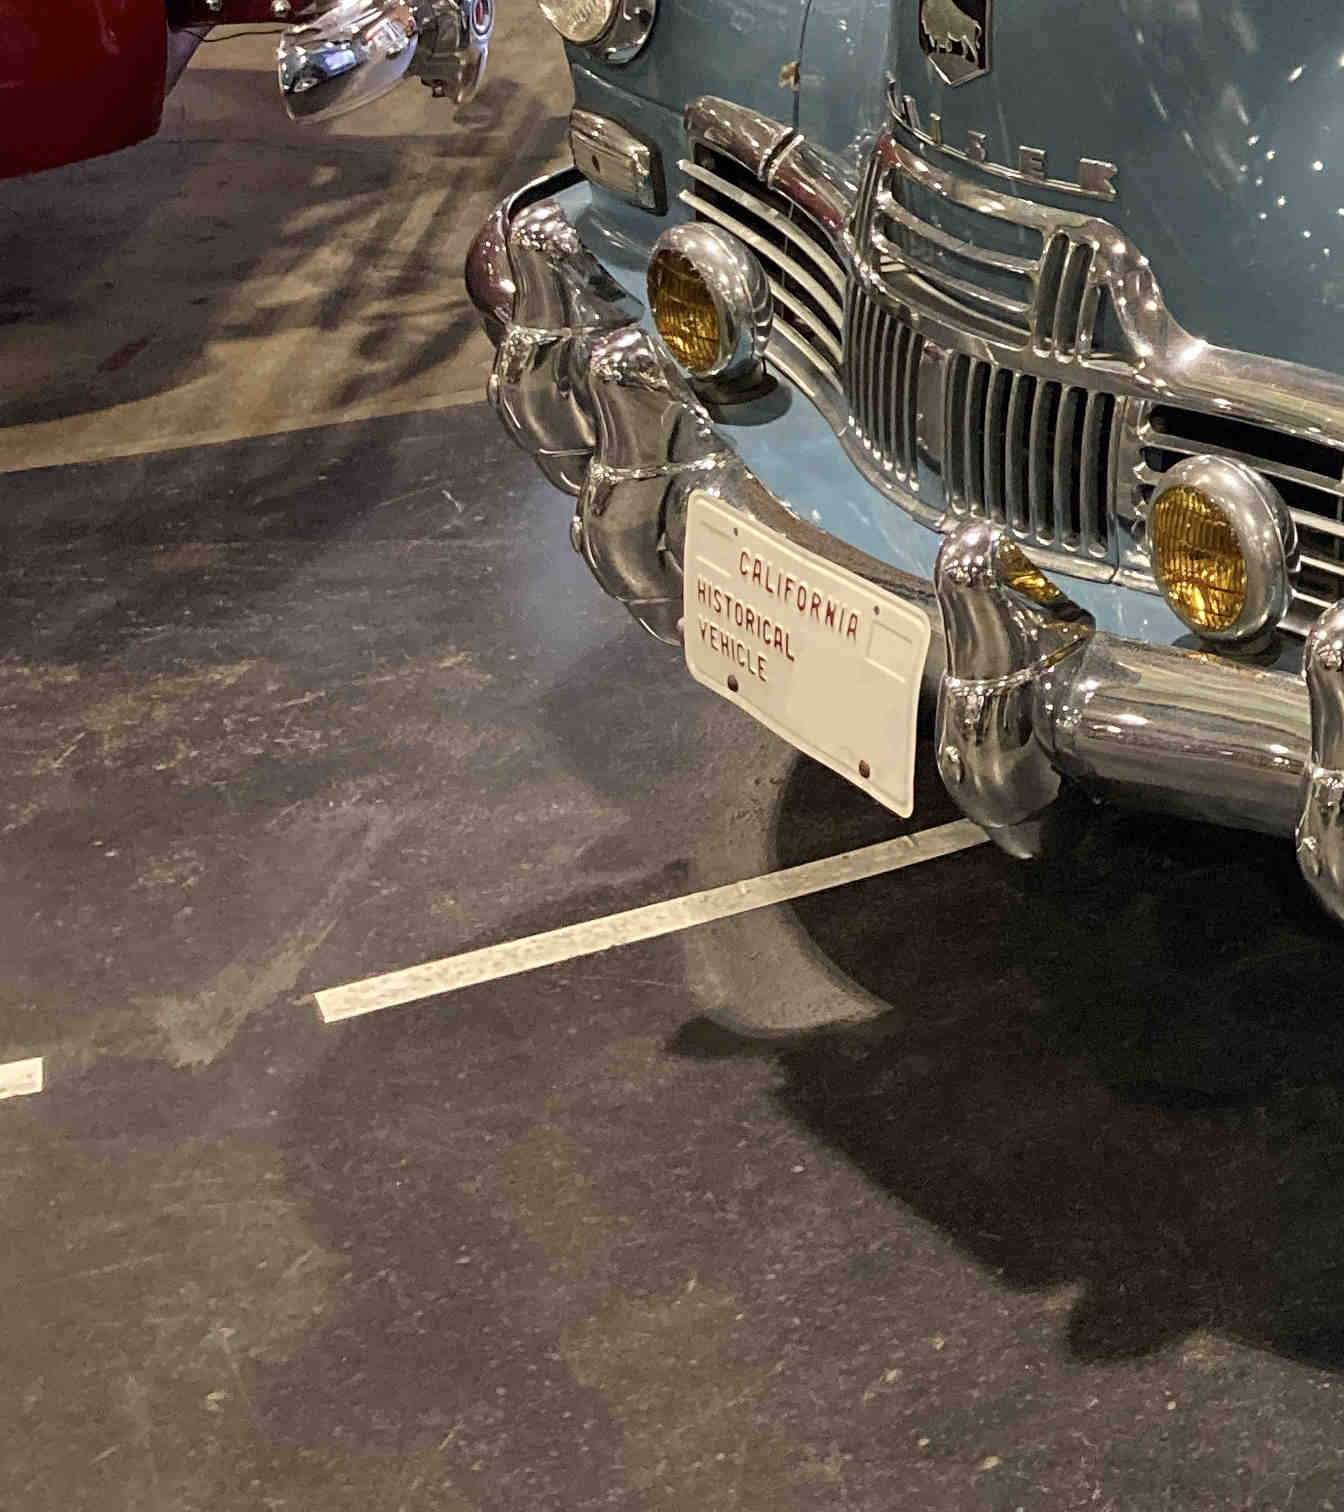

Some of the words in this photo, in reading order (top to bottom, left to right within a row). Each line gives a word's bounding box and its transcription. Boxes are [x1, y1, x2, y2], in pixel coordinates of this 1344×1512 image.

[696, 576, 796, 662] HISTORICAL
[738, 550, 861, 640] CALIFORNIA
[698, 618, 769, 683] VEHICLE
